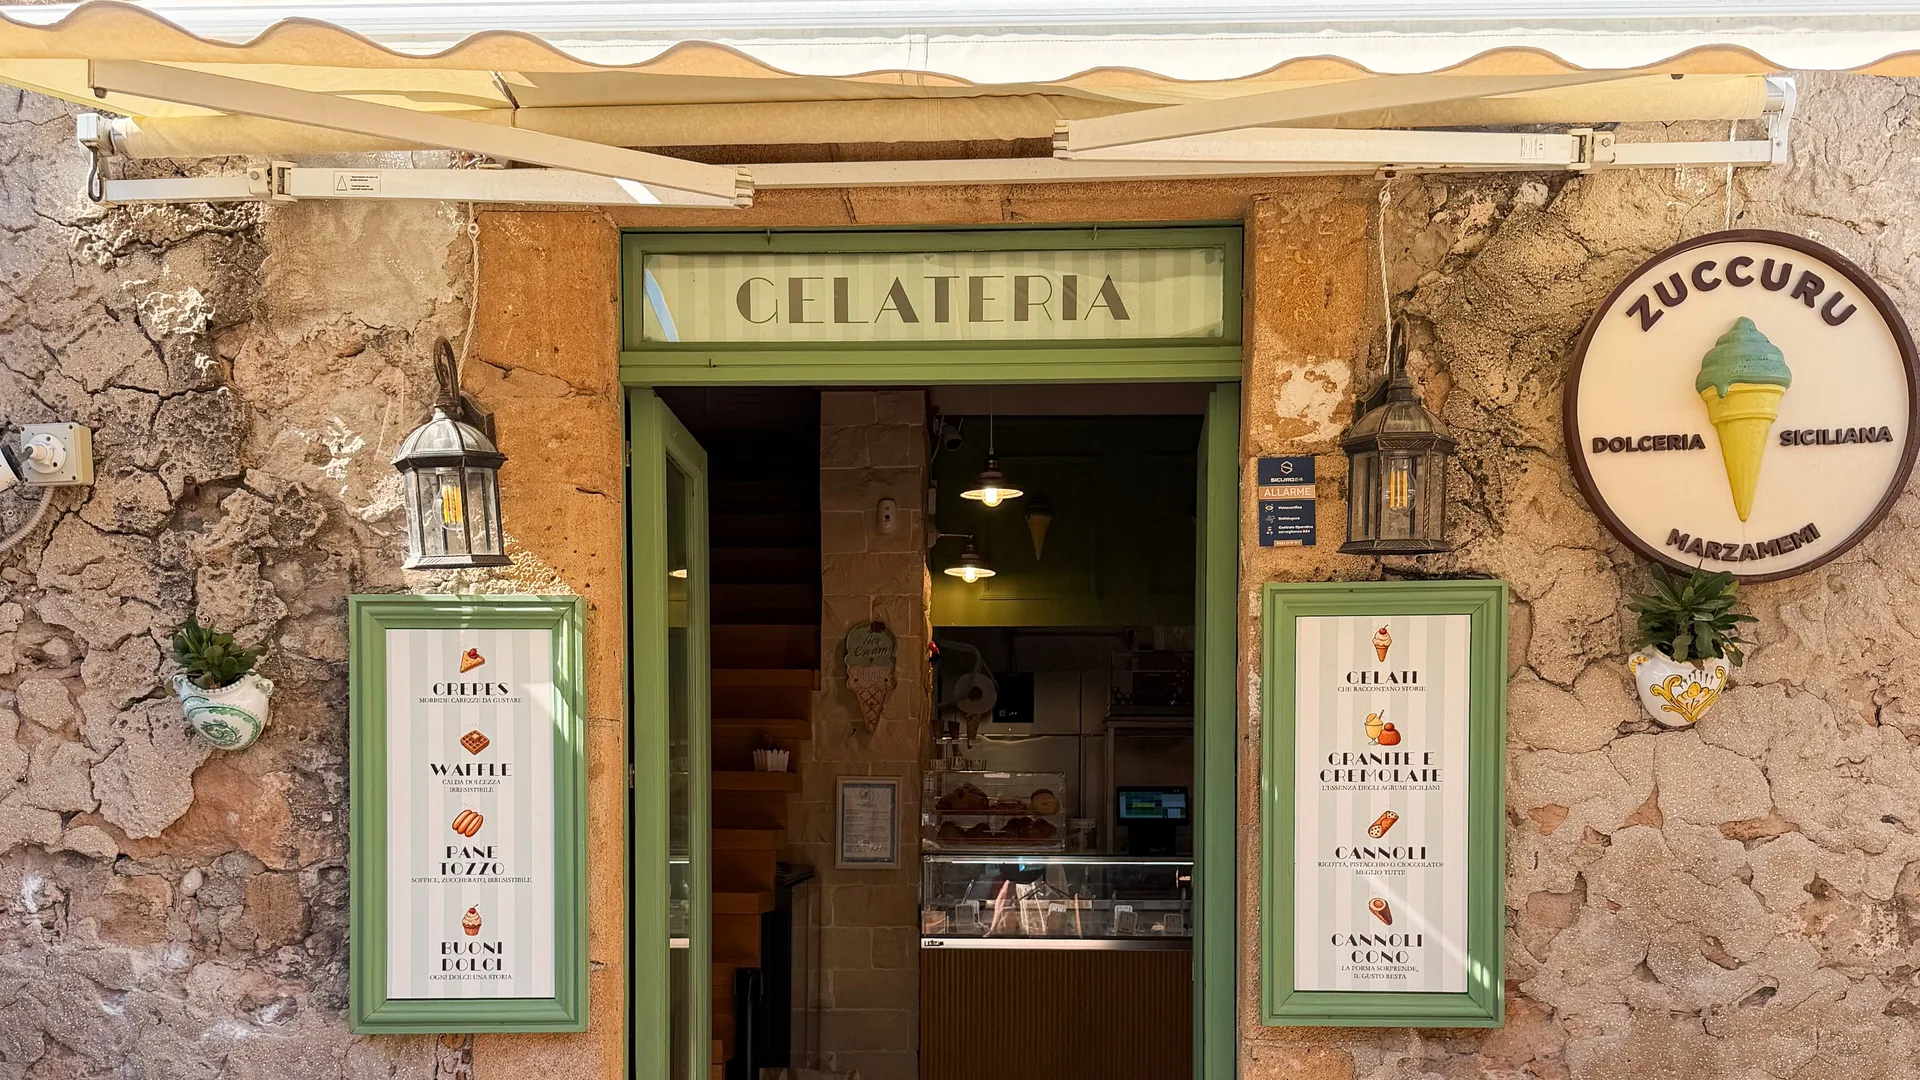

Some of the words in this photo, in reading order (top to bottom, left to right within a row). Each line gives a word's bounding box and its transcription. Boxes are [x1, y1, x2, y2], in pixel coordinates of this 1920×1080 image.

[736, 274, 1130, 324] GELATERIA
[1626, 256, 1858, 332] ZUCCURU
[1592, 434, 1706, 454] DOLCERIA
[1779, 426, 1893, 447] SICILIANA
[1263, 487, 1312, 497] ALLARME
[1666, 522, 1821, 562] MARZAMEMI
[1346, 671, 1418, 685] GELATI
[433, 682, 509, 696] CREPES
[1328, 752, 1415, 766] GRANITE
[1423, 752, 1435, 765] E
[430, 763, 512, 777] WAFFLE
[1320, 769, 1443, 783] CREMOLATE
[446, 846, 498, 859] PANE
[1335, 846, 1426, 860] CANNOLI
[439, 862, 505, 876] TOZZO
[1331, 933, 1423, 948] CANNOLI
[441, 941, 503, 955] BUONI
[1351, 950, 1409, 964] CONO
[441, 958, 502, 972] DOLCI
